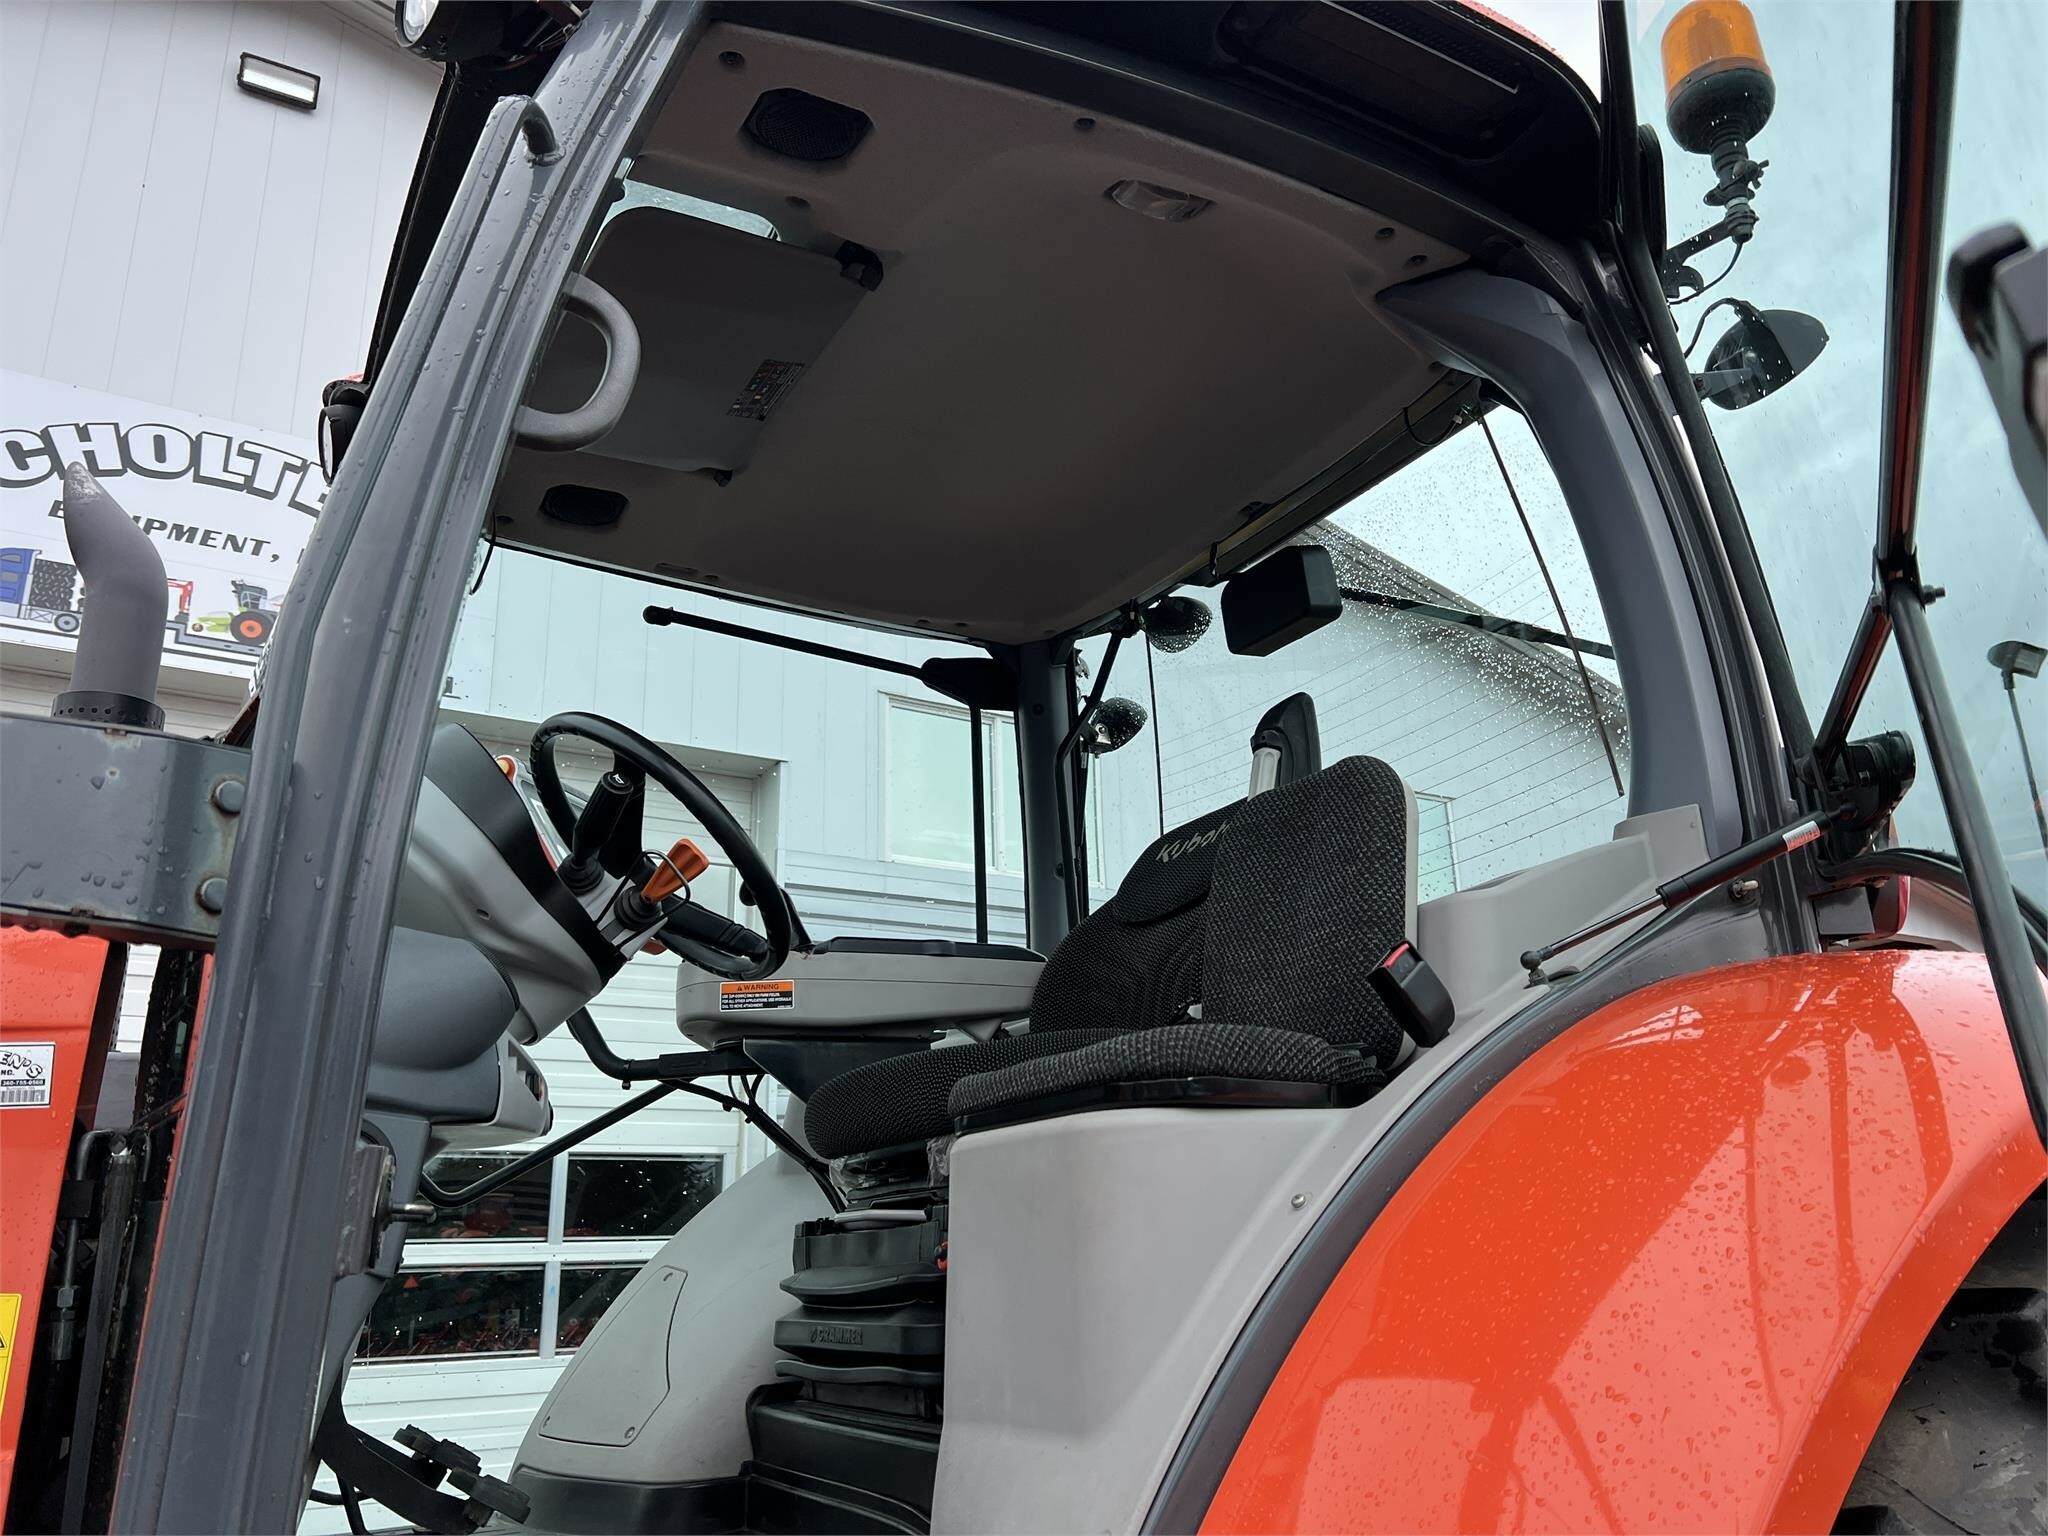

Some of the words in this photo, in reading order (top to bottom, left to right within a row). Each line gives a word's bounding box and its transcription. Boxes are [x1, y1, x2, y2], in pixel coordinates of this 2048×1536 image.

[48, 500, 280, 563] EIPMENT,
[1155, 819, 1230, 862] Kubot
[744, 983, 779, 991] WARNING
